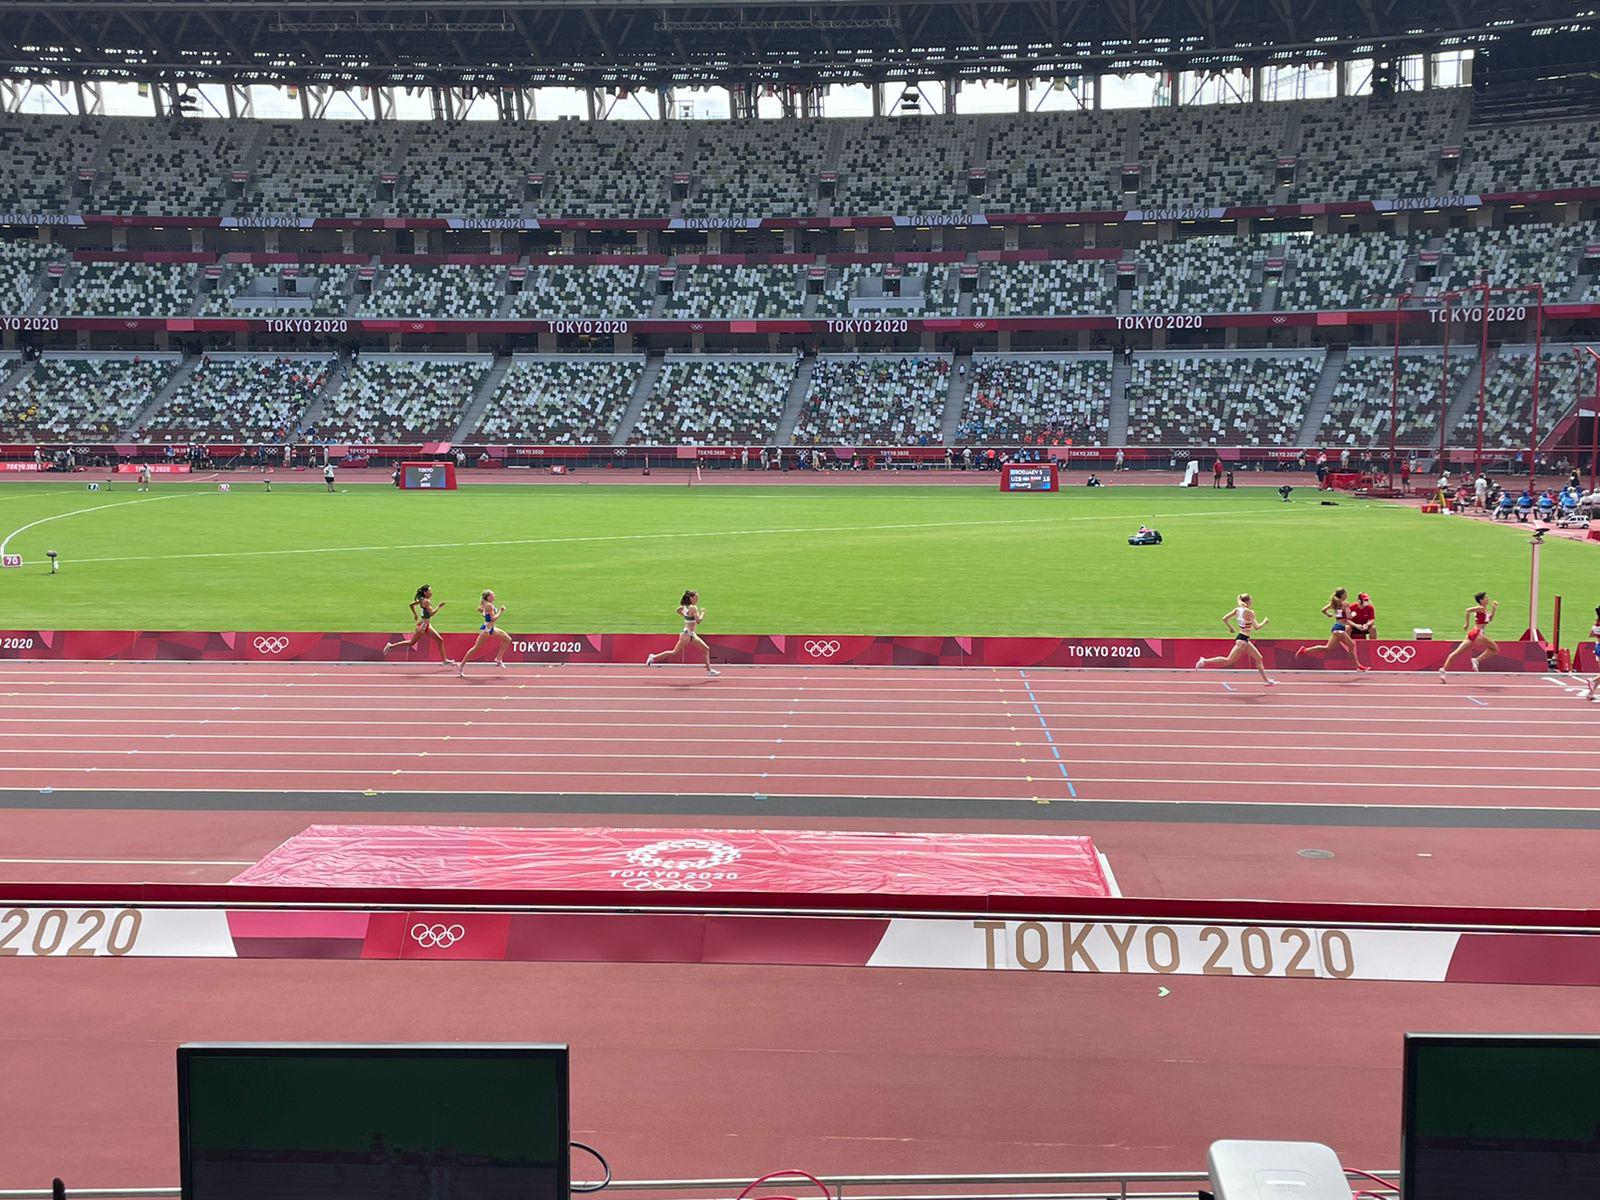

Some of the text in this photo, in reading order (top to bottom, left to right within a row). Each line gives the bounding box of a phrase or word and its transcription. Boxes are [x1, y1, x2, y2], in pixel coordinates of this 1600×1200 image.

[1391, 195, 1465, 210] TOKYO 2020
[1, 215, 69, 225] TOKYO 2020
[1141, 208, 1210, 220] TOKYO 2020
[236, 217, 300, 227] TOKYO 2020
[463, 219, 526, 229] TOKYO 2020
[683, 218, 747, 228] TOKYO 2020
[908, 215, 972, 226] TOKYO 2020
[1429, 307, 1526, 322] TOKYO 2020
[0, 317, 59, 330] YO 2020
[266, 320, 347, 332] TOKYO 2020
[548, 321, 628, 334] TOKYO 2020
[827, 320, 908, 333] TOKYO 2020
[1116, 315, 1202, 329] TOKYO 2020
[6, 557, 19, 565] 70
[3, 638, 34, 649] 2020
[512, 641, 581, 653] TOKYO 2020
[1068, 645, 1141, 657] TOKYO 2020
[608, 869, 738, 880] TOKYO 2020
[0, 908, 142, 956] 2020
[973, 921, 1355, 978] TOKYO 2020
